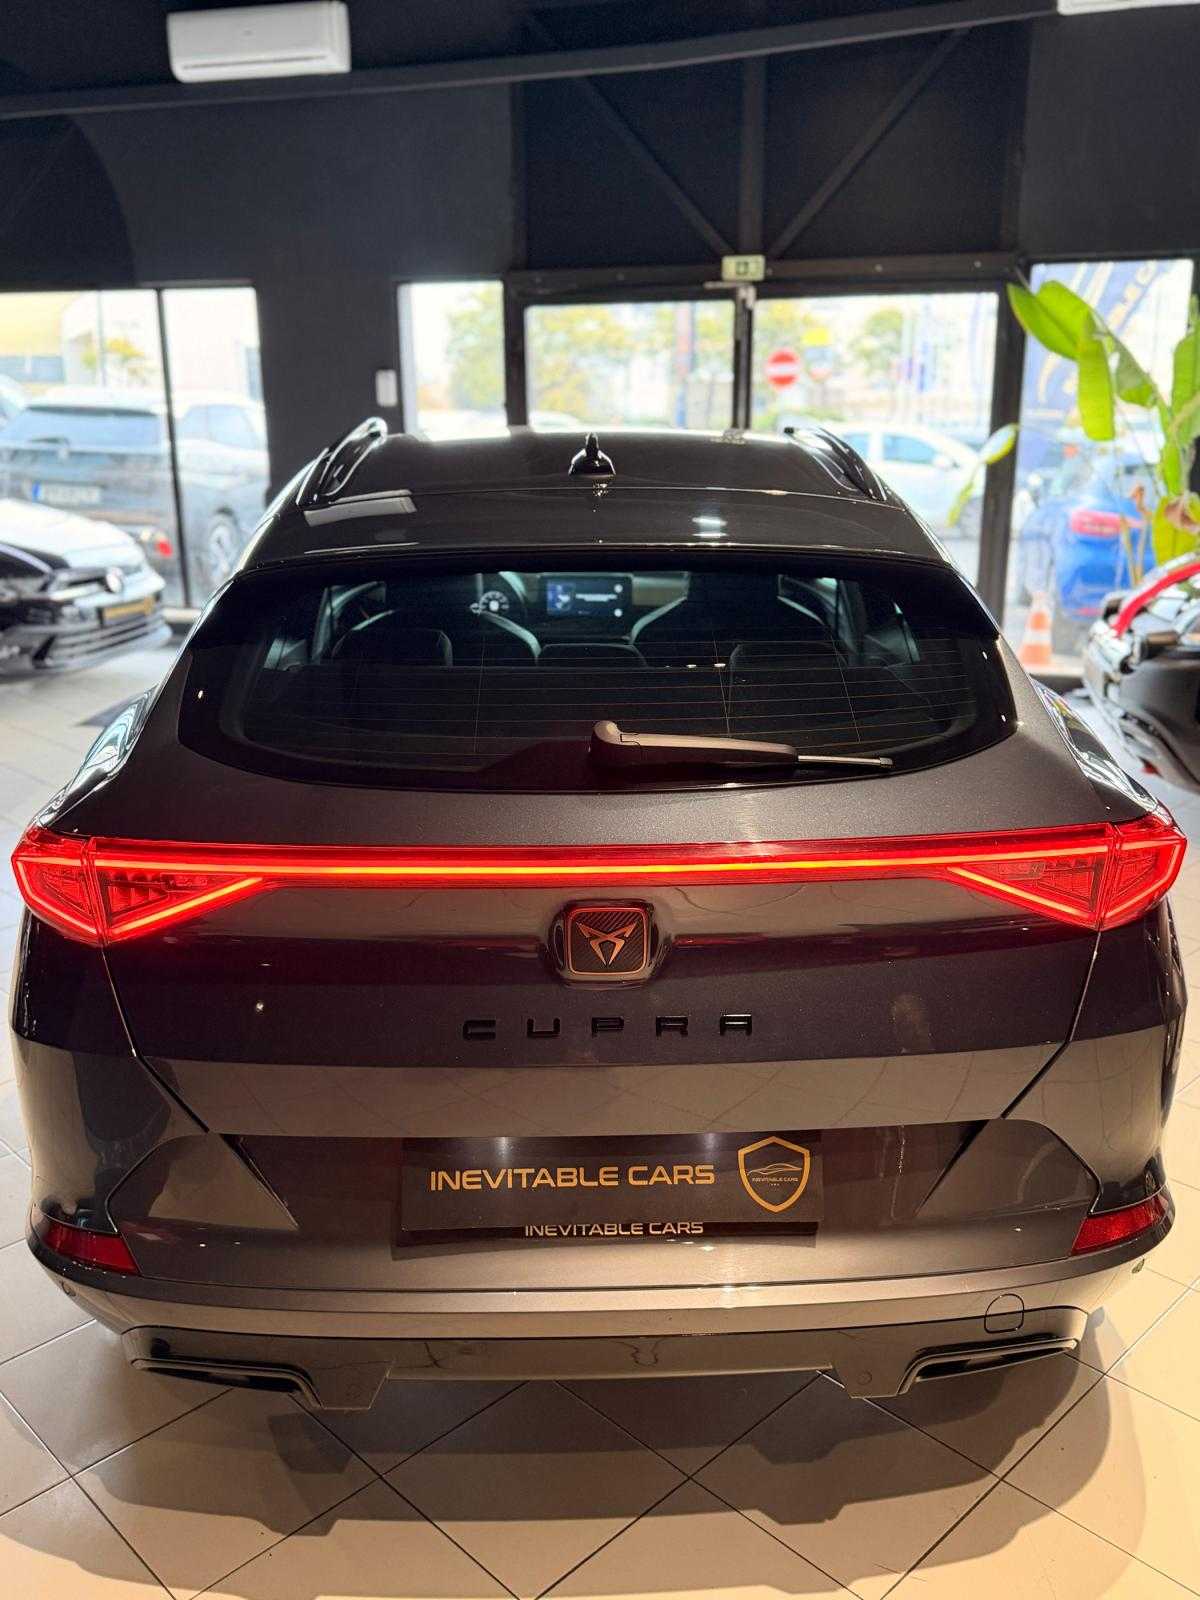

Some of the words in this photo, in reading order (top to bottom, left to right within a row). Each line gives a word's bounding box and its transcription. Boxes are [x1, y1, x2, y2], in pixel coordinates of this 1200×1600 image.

[462, 1013, 753, 1040] CUPRA
[430, 1167, 619, 1191] INEVITABLE
[628, 1164, 716, 1186] CARS
[525, 1222, 644, 1237] INEVITABLE
[649, 1221, 704, 1235] CARS
